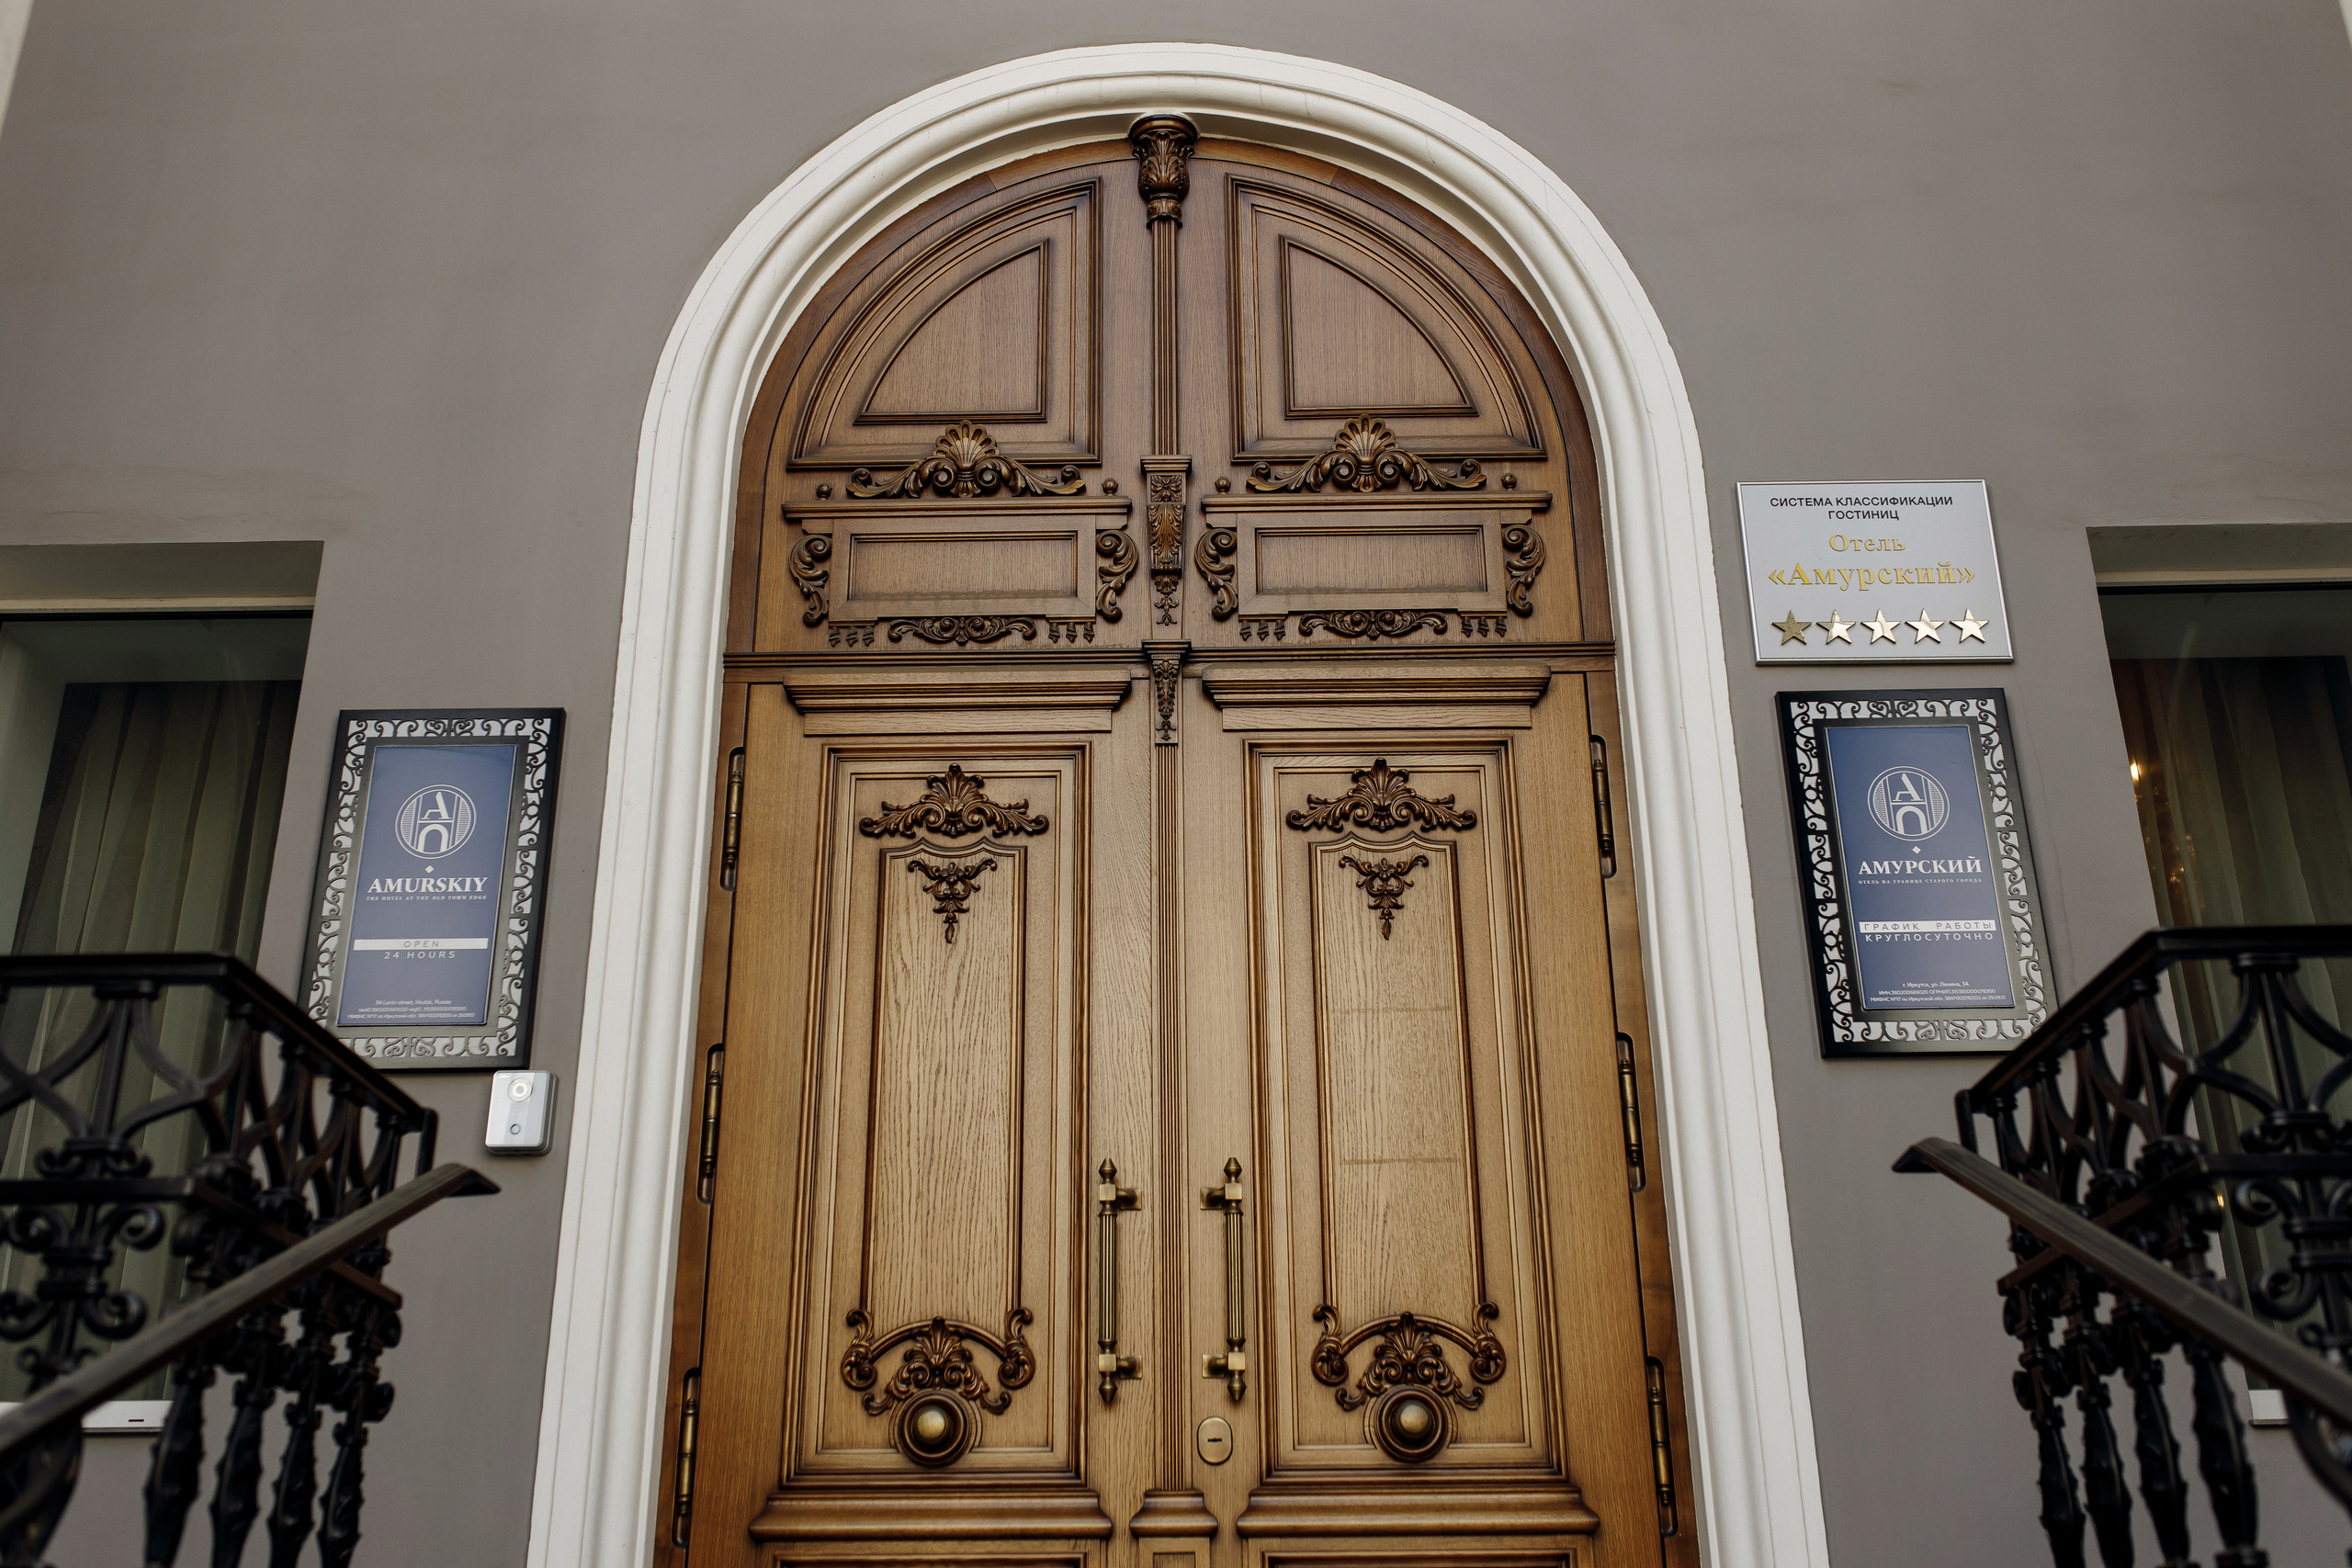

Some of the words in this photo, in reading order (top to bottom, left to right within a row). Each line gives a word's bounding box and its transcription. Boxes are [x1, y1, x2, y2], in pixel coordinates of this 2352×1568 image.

[1770, 497, 1833, 507] СИСТЕМА
[1836, 496, 1953, 507] КЛАССИФИКАЦИИ
[1827, 510, 1900, 521] ГОСТИНИЦ
[1829, 535, 1906, 552] Отель
[1768, 561, 1976, 592] «Амурский»
[1859, 855, 1984, 874] АМУРСКИЙ
[367, 877, 489, 893] AMURSKIY
[1864, 922, 1919, 931] ГРАФИК
[1936, 921, 1992, 931] РАБОТЫ
[1865, 932, 1994, 942] КРУГЛОСУТОЧНО
[406, 951, 456, 959] HOURS
